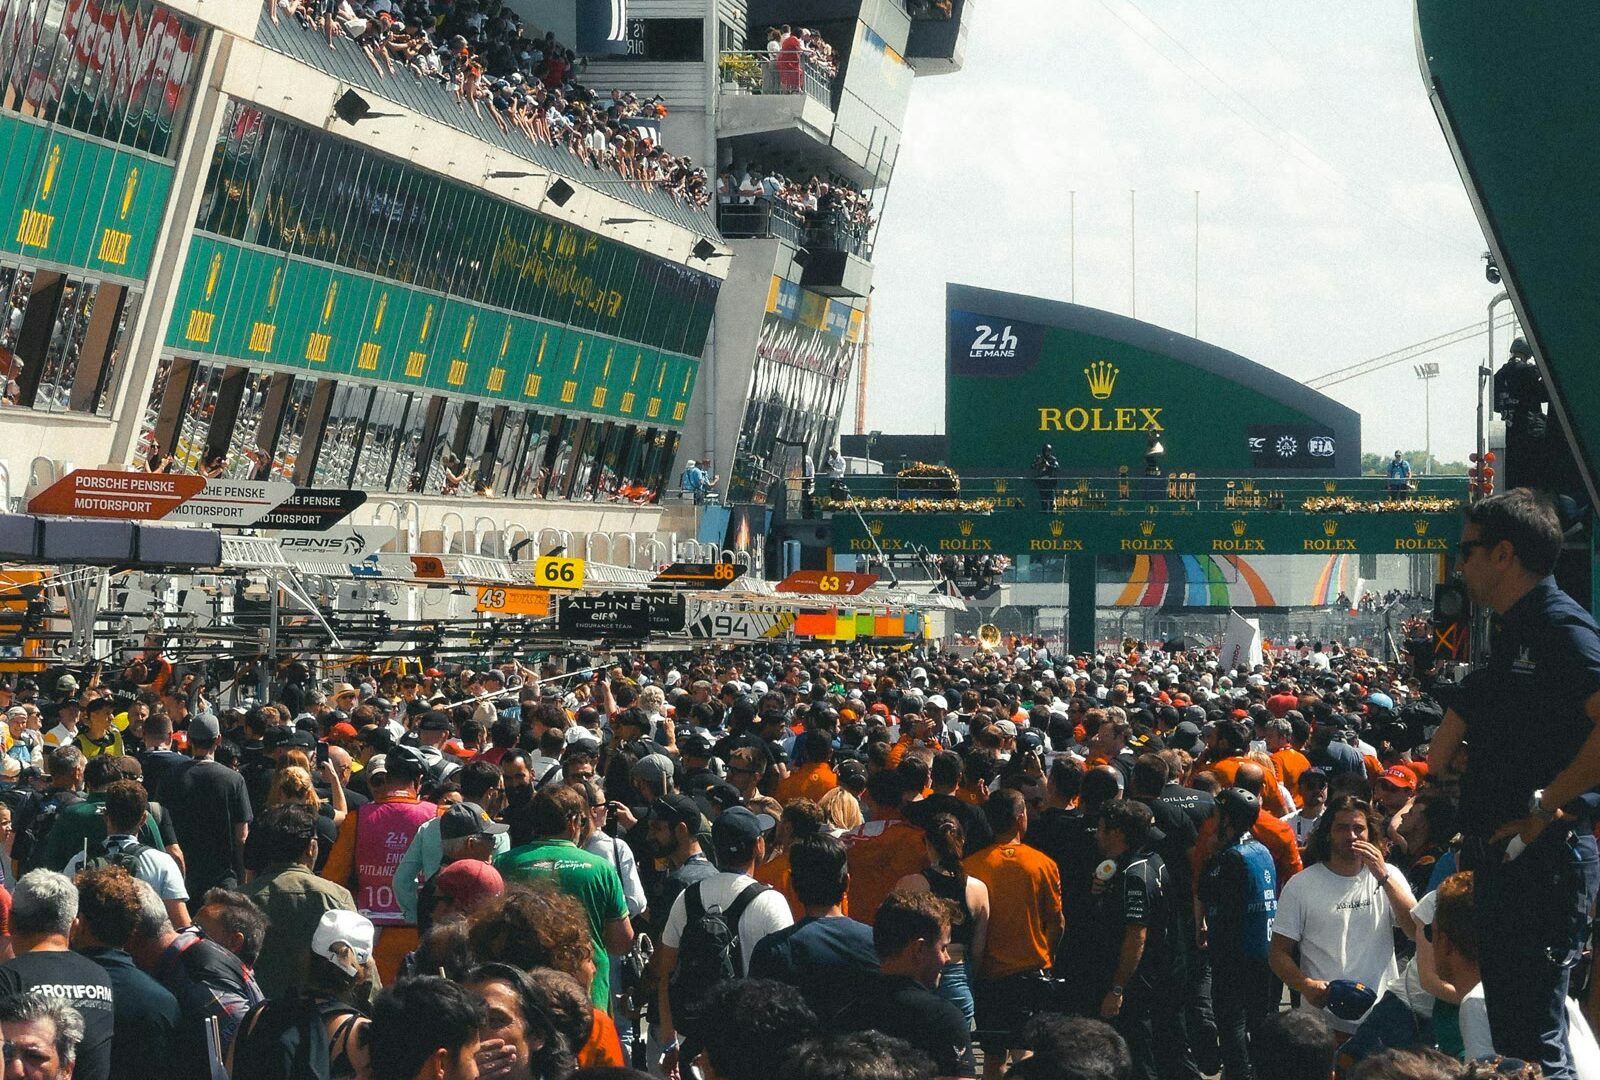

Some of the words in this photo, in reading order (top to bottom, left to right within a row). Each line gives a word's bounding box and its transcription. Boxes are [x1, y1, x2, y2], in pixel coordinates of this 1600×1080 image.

[969, 350, 982, 358] LE
[984, 350, 1015, 358] MANS
[1038, 408, 1165, 432] ROLEX
[75, 476, 128, 490] PORSCHE
[130, 479, 175, 493] PENSKE
[224, 486, 265, 499] PENSKE
[74, 498, 153, 513] MOTORSPORT
[302, 496, 341, 506] PENSKE
[940, 539, 992, 550] ROLEX
[1030, 540, 1083, 550] ROLEX
[1120, 540, 1174, 550] ROLEX
[1212, 540, 1265, 550] ROLEX
[1303, 540, 1357, 550] ROLEX
[1394, 539, 1448, 549] ROLEX
[544, 562, 575, 582] 66
[714, 564, 734, 580] 86
[819, 575, 840, 591] 63
[480, 589, 506, 609] 43
[568, 601, 641, 611] ALPINE
[715, 616, 748, 637] 94
[41, 984, 112, 1002] ROTIFORM
